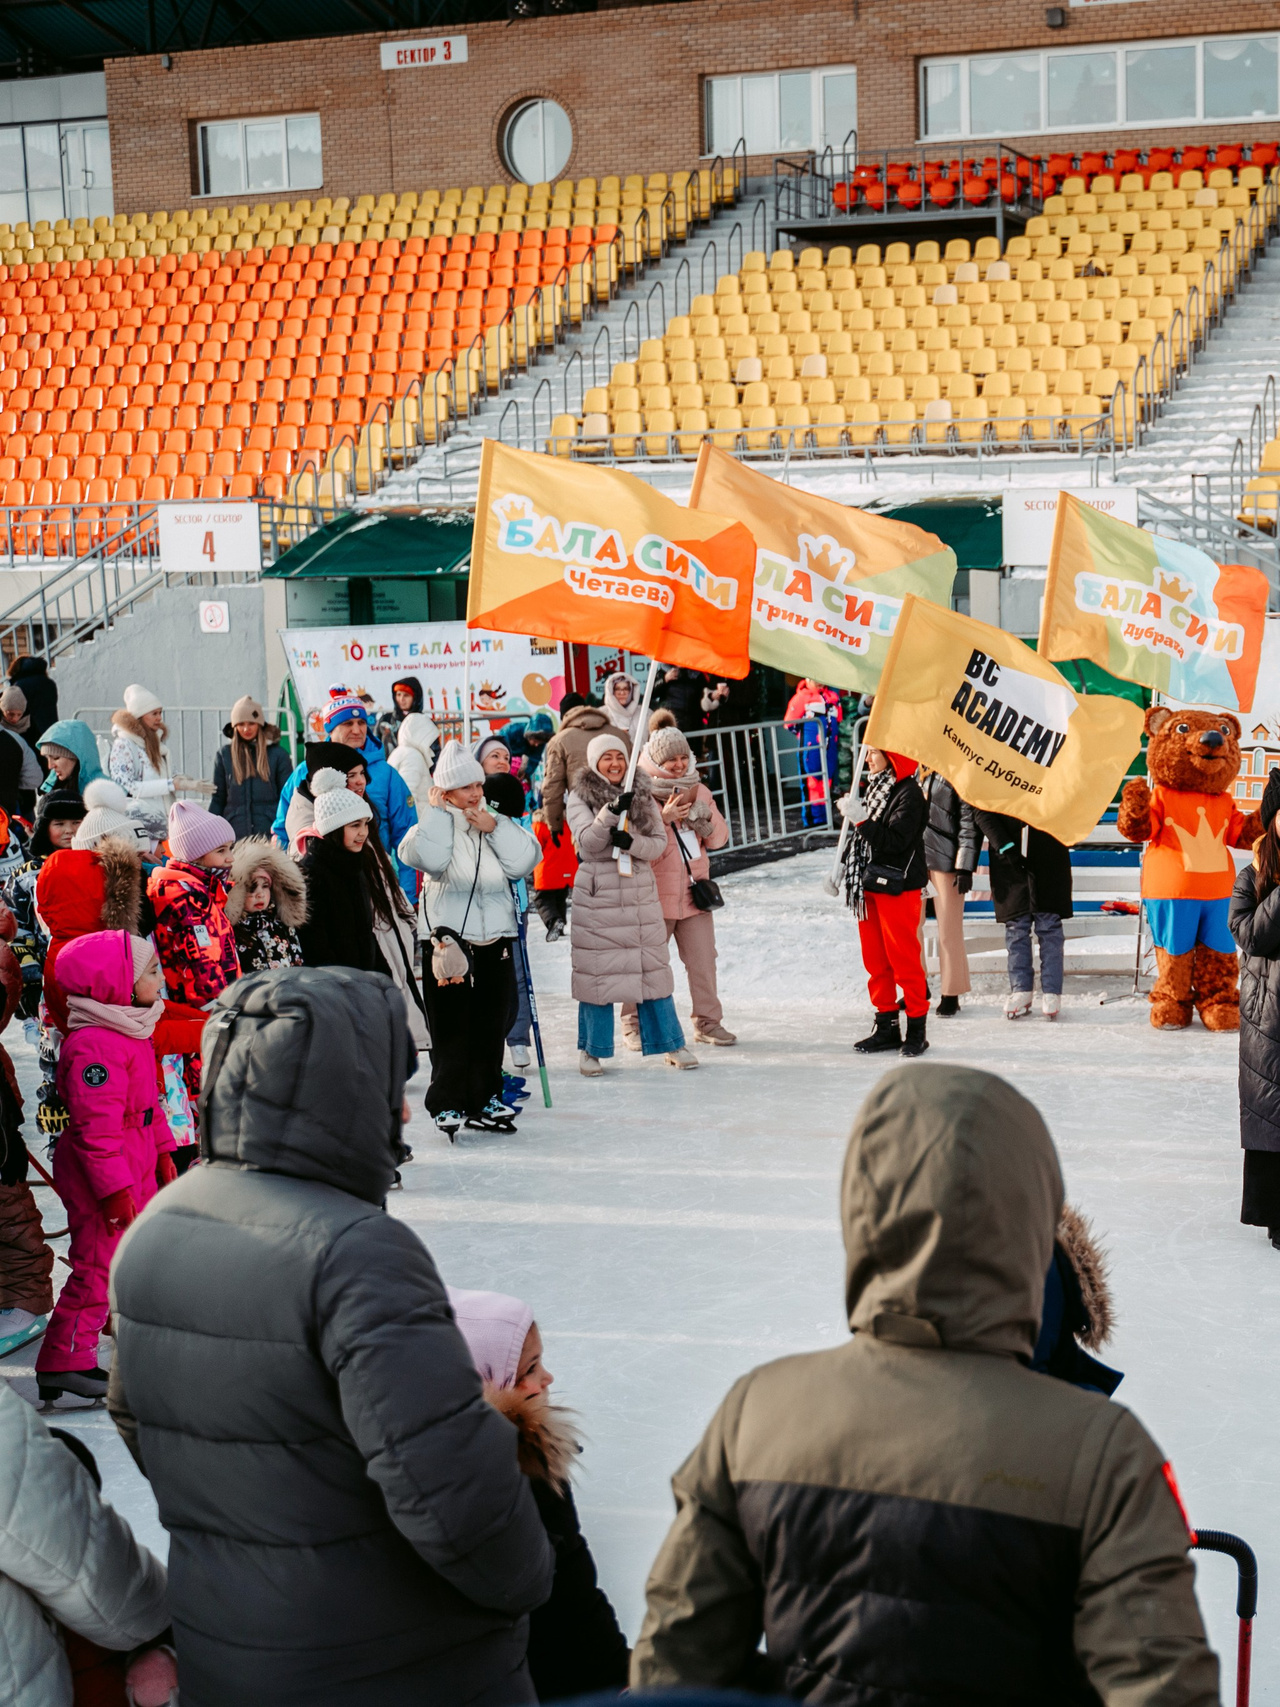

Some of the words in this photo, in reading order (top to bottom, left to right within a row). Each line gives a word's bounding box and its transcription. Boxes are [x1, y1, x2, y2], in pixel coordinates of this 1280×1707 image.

[396, 47, 436, 66] СЕКТОР
[443, 40, 452, 61] 3
[174, 514, 203, 524] SECTOR
[202, 531, 216, 562] 4
[504, 518, 621, 564] БАЛА
[641, 540, 731, 607] СИТИ
[569, 569, 670, 607] Четаева
[755, 557, 814, 604] ЛА
[821, 585, 899, 631] СИТ
[757, 597, 809, 628] Грин
[813, 618, 862, 648] Сити
[1081, 578, 1162, 620] БАЛА
[1169, 605, 1238, 654] СИИ
[341, 643, 364, 661] 10
[367, 644, 400, 658] ЛЕТ
[409, 642, 453, 656] БАЛА
[1123, 622, 1185, 659] Дубрава
[964, 648, 1001, 687] BC
[950, 680, 1067, 769] ACADEMY
[942, 724, 984, 766] Кампус
[984, 759, 1044, 796] Дубрава
[511, 882, 523, 925] FISCHE
